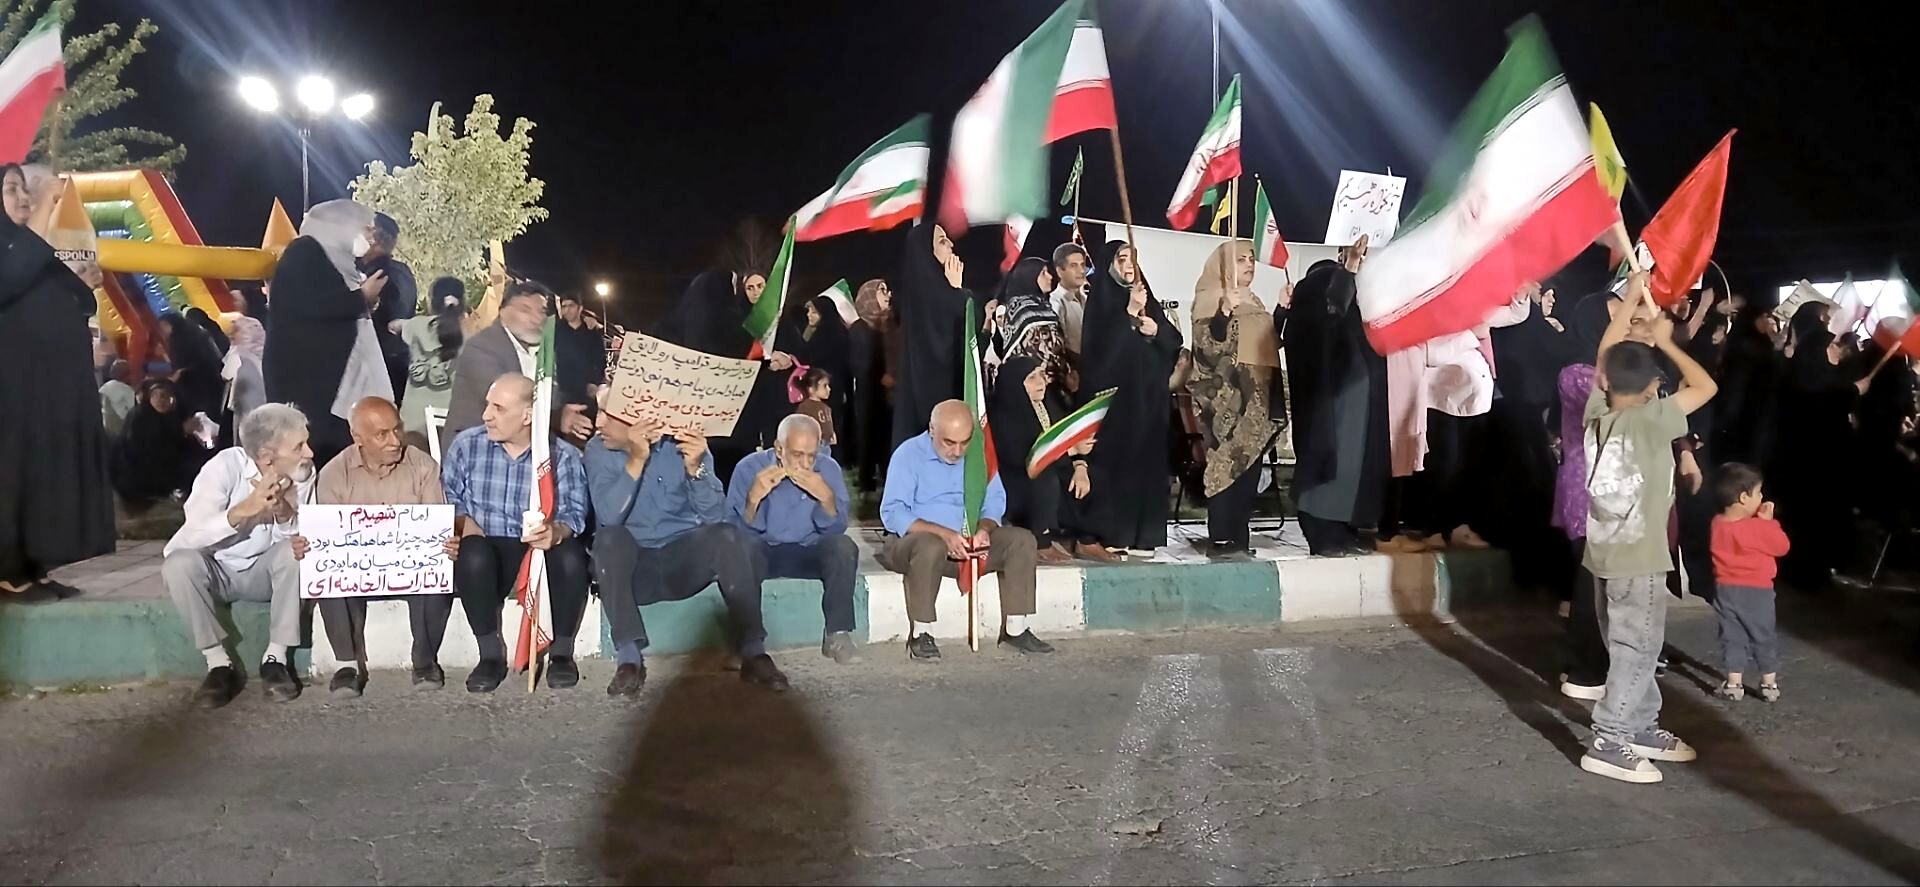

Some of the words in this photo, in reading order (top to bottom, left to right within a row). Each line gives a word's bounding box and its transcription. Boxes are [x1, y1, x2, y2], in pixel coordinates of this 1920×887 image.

[350, 503, 397, 531] شهیدم
[398, 506, 429, 529] امام
[376, 531, 393, 546] شما
[315, 557, 345, 573] بودی
[347, 552, 357, 569] ما
[359, 554, 400, 572] میان
[401, 549, 444, 571] اکنون
